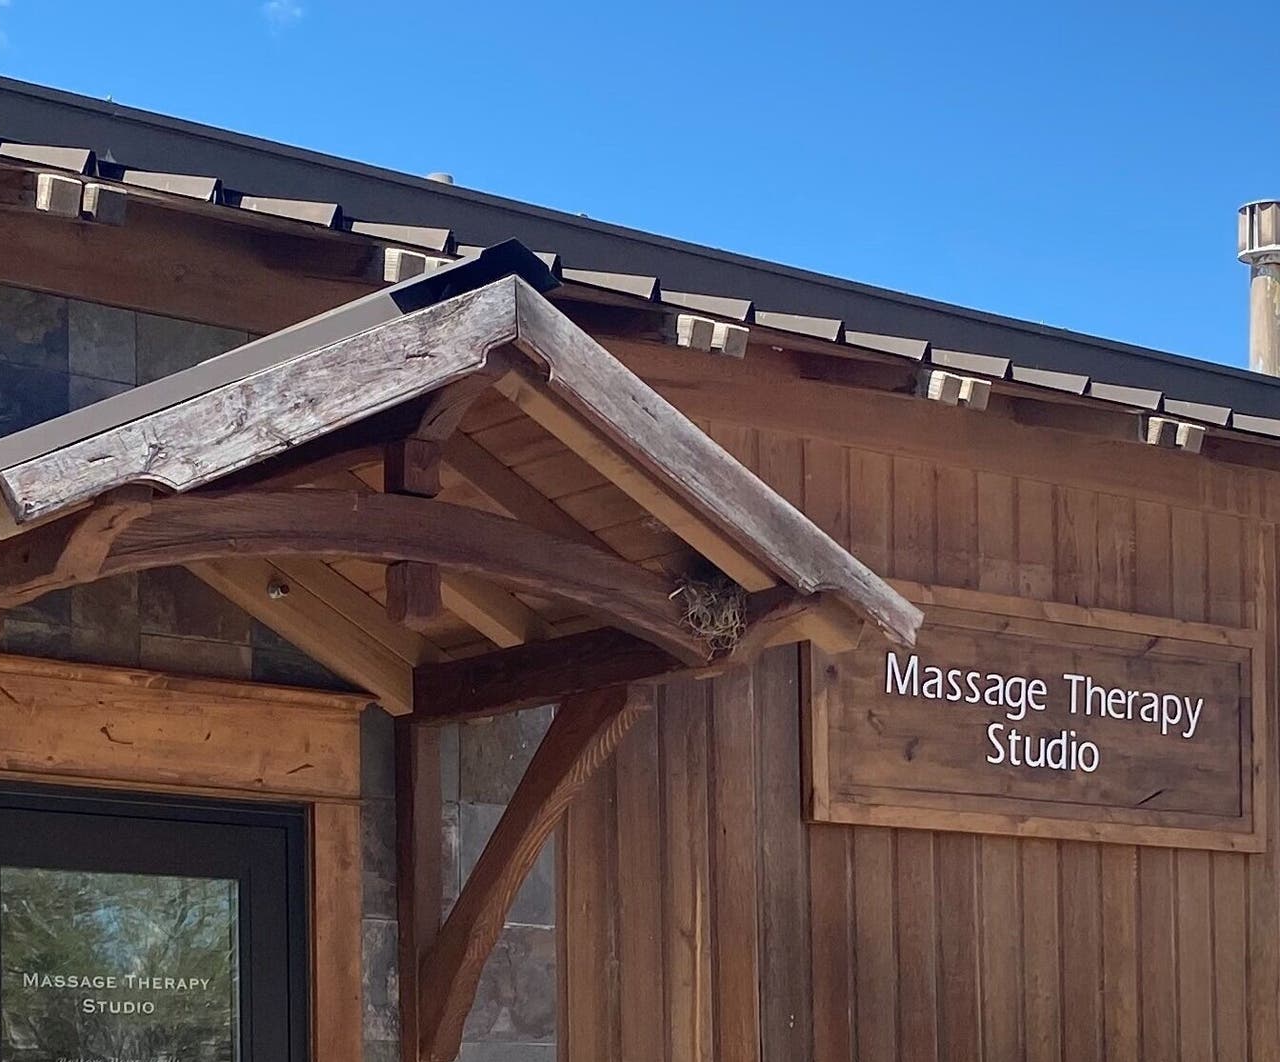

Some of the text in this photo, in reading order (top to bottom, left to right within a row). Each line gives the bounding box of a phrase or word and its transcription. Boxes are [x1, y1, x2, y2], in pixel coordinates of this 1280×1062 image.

[885, 652, 1204, 738] Massage Therapy
[986, 723, 1100, 772] Studio
[23, 972, 211, 991] MASSAGE THERAPY
[82, 999, 155, 1014] STUDIO
